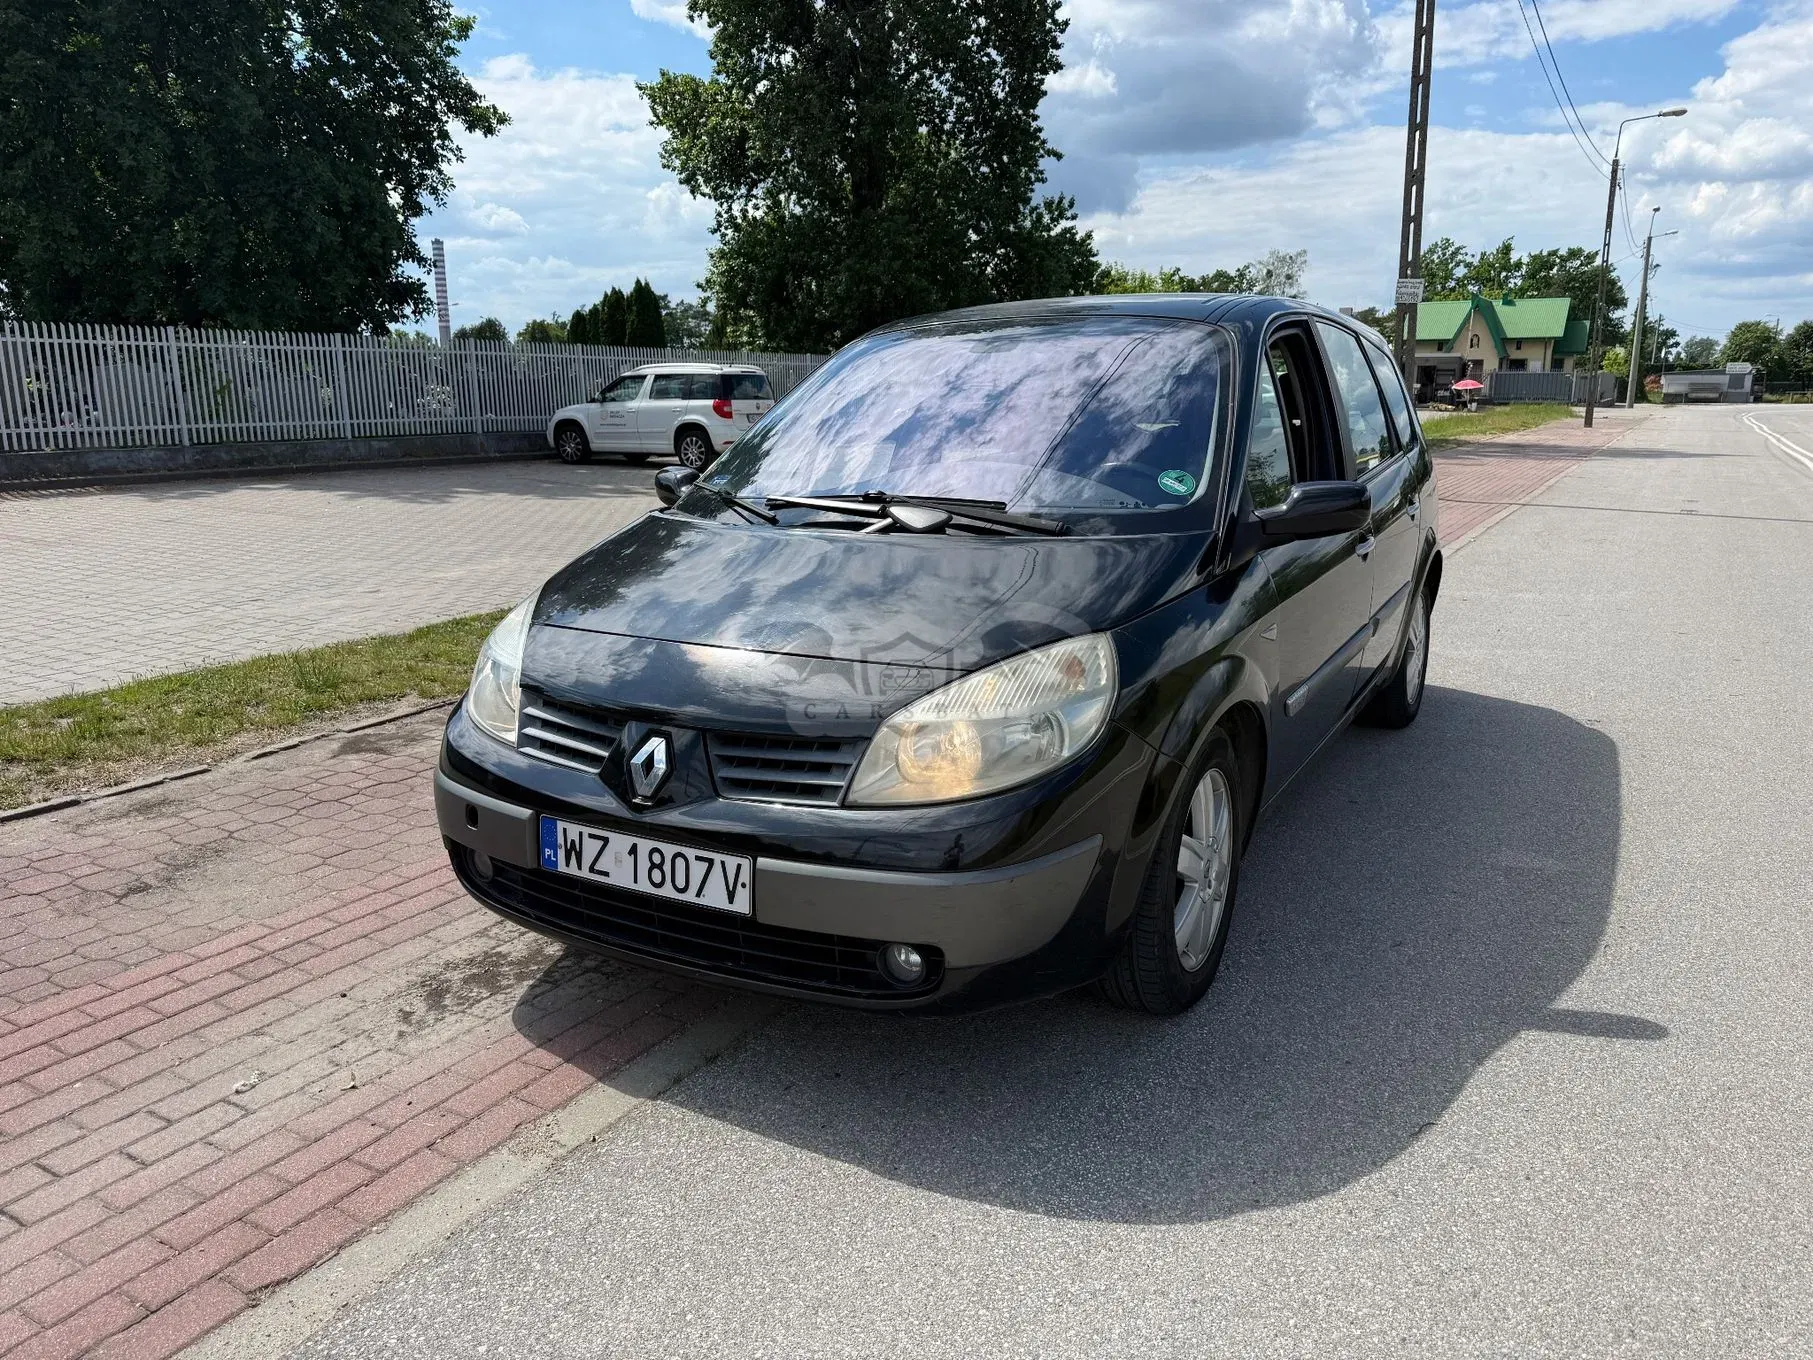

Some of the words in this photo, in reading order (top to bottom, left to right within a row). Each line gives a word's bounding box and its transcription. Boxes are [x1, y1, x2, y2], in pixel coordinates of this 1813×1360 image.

[544, 848, 557, 861] PL
[562, 826, 610, 878] WZ
[627, 842, 743, 905] 1807V
